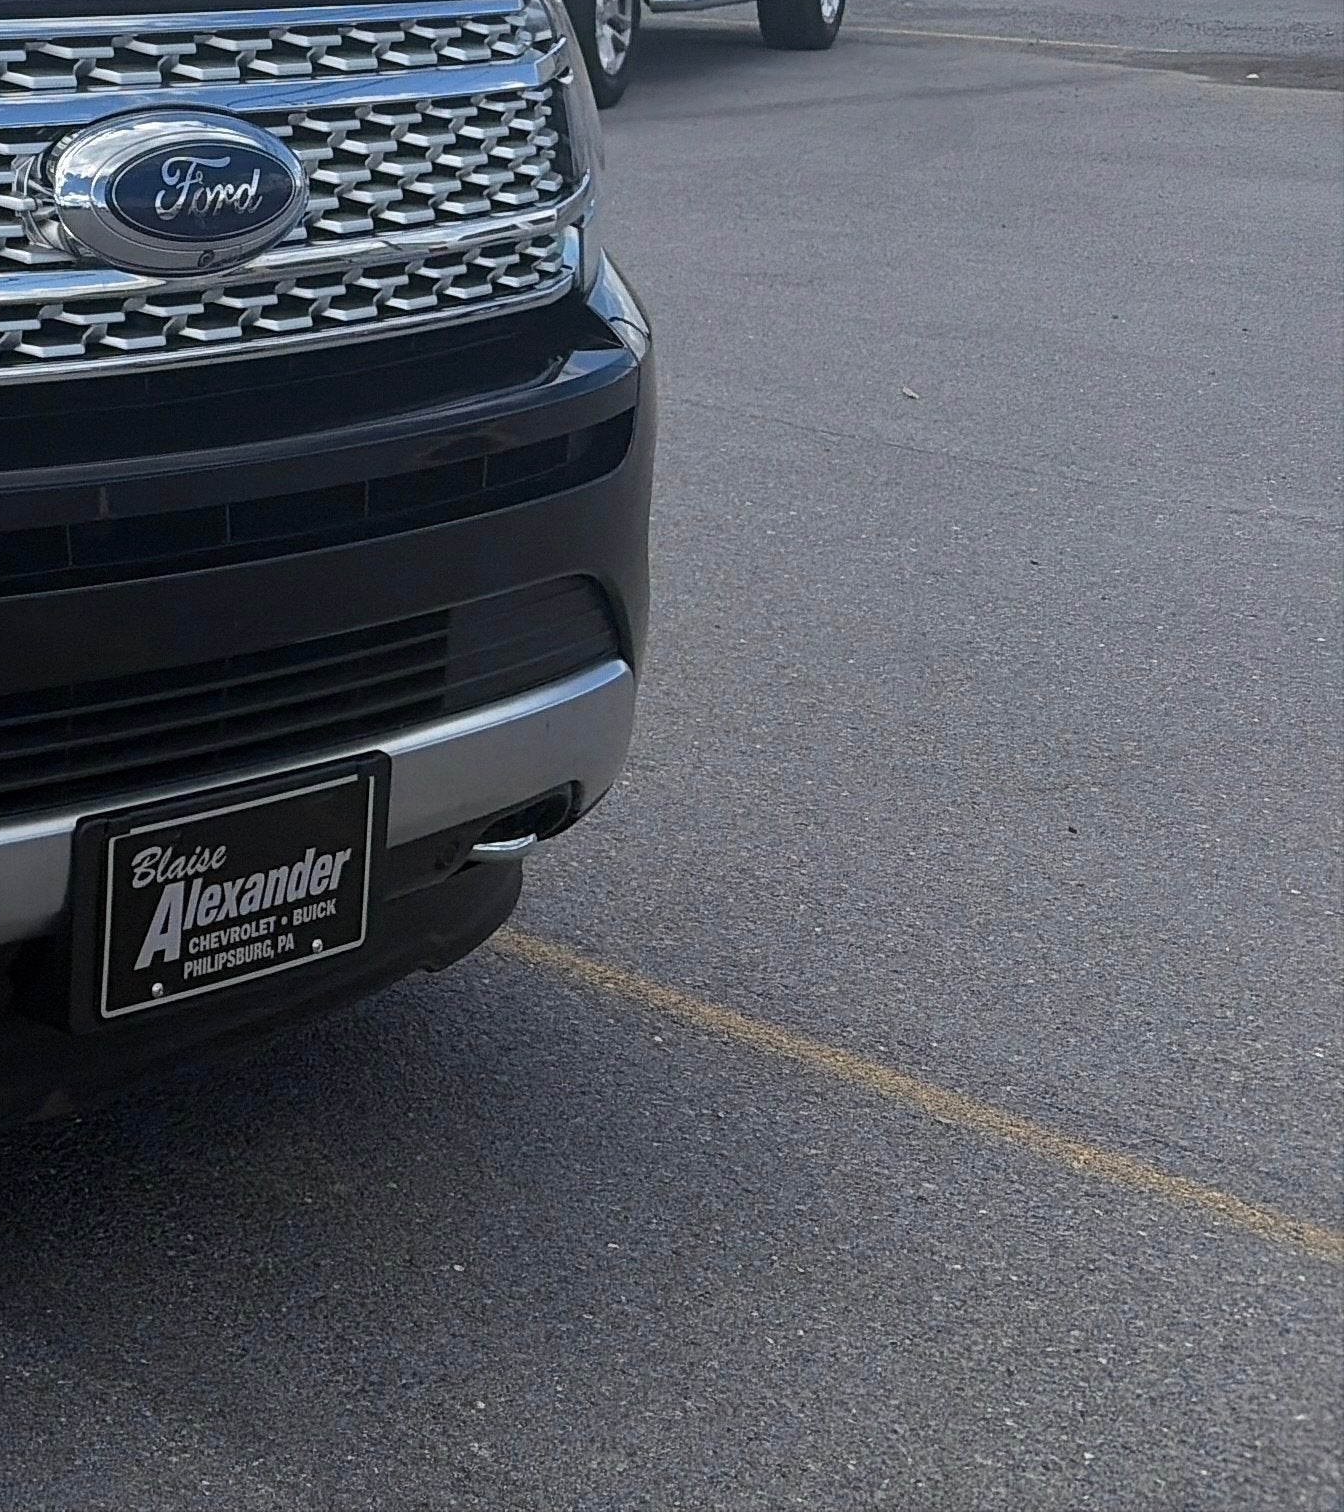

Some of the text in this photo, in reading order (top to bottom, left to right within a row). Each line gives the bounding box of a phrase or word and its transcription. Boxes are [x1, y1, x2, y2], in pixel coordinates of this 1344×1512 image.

[154, 156, 263, 221] Ford
[131, 845, 228, 889] Blaise
[133, 848, 352, 971] Alexander
[188, 898, 337, 954] CHEVROLET BUICK
[183, 932, 295, 980] PHILIPSBURG, PA
